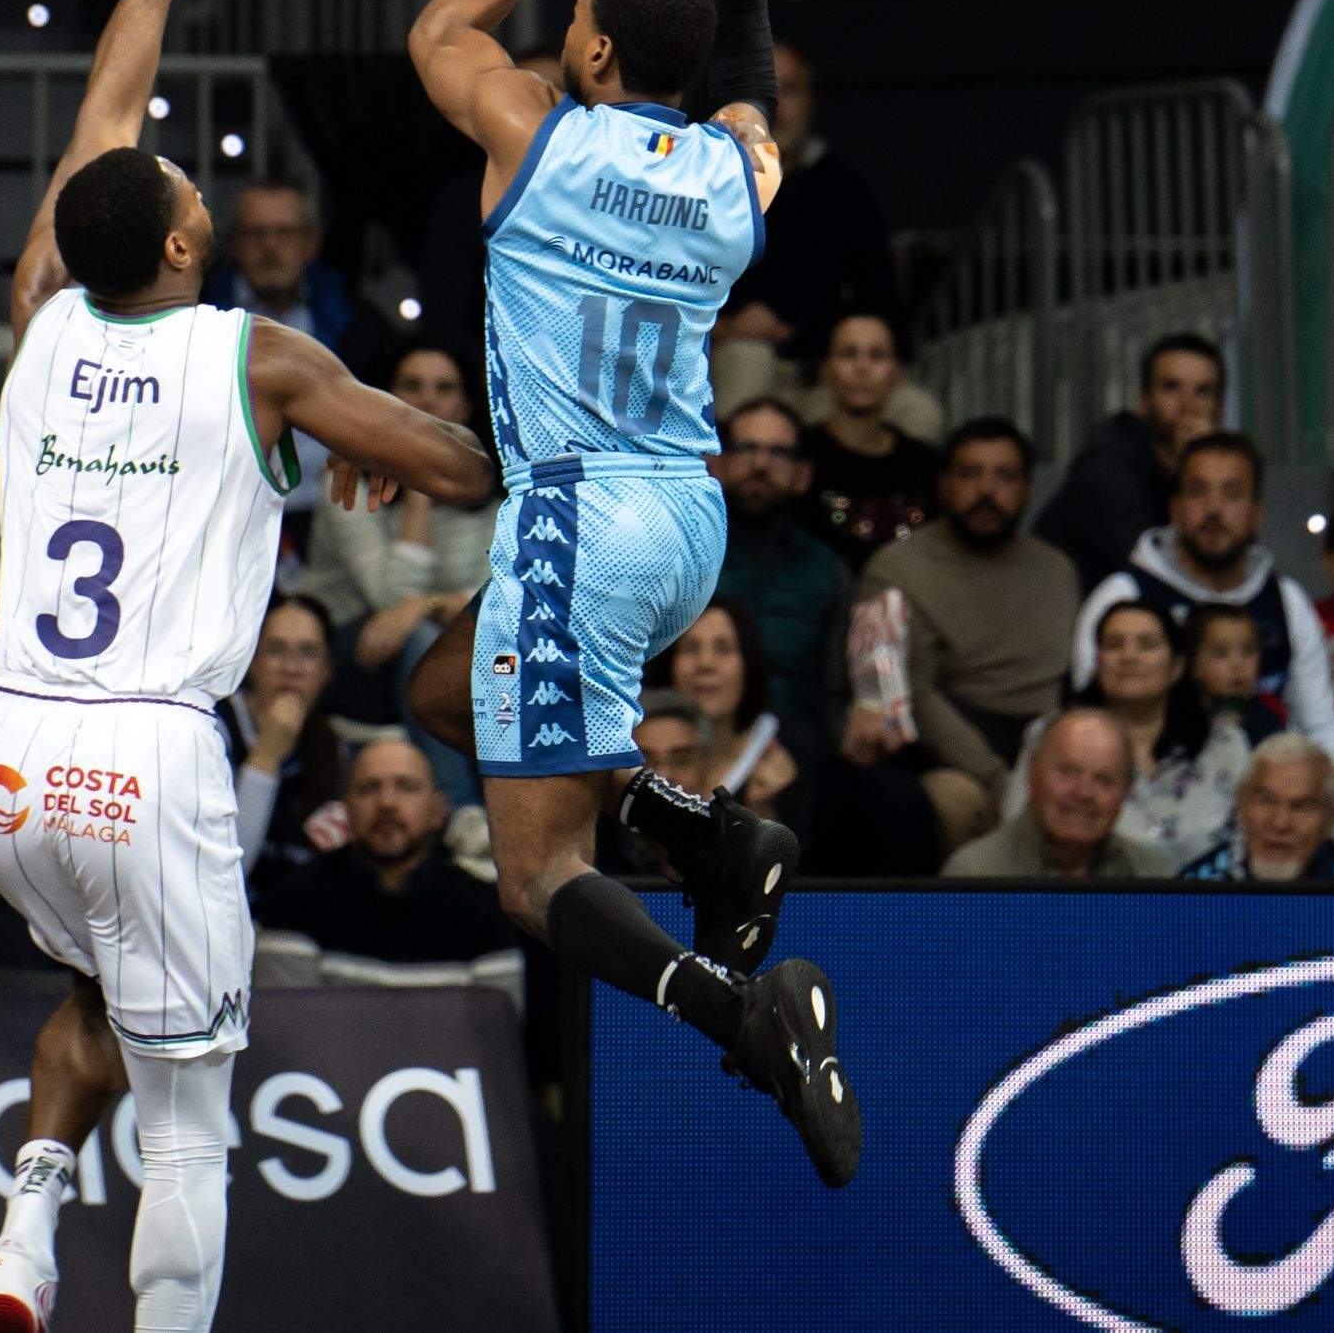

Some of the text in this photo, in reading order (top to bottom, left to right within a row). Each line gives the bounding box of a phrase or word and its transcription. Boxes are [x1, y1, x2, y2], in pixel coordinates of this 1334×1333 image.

[590, 177, 709, 231] HARDING
[572, 241, 722, 284] MORABANC
[70, 358, 160, 414] Ejim
[576, 293, 683, 436] 10
[36, 520, 124, 659] 3
[44, 793, 137, 824] DEL SOL
[46, 765, 141, 799] COSTA
